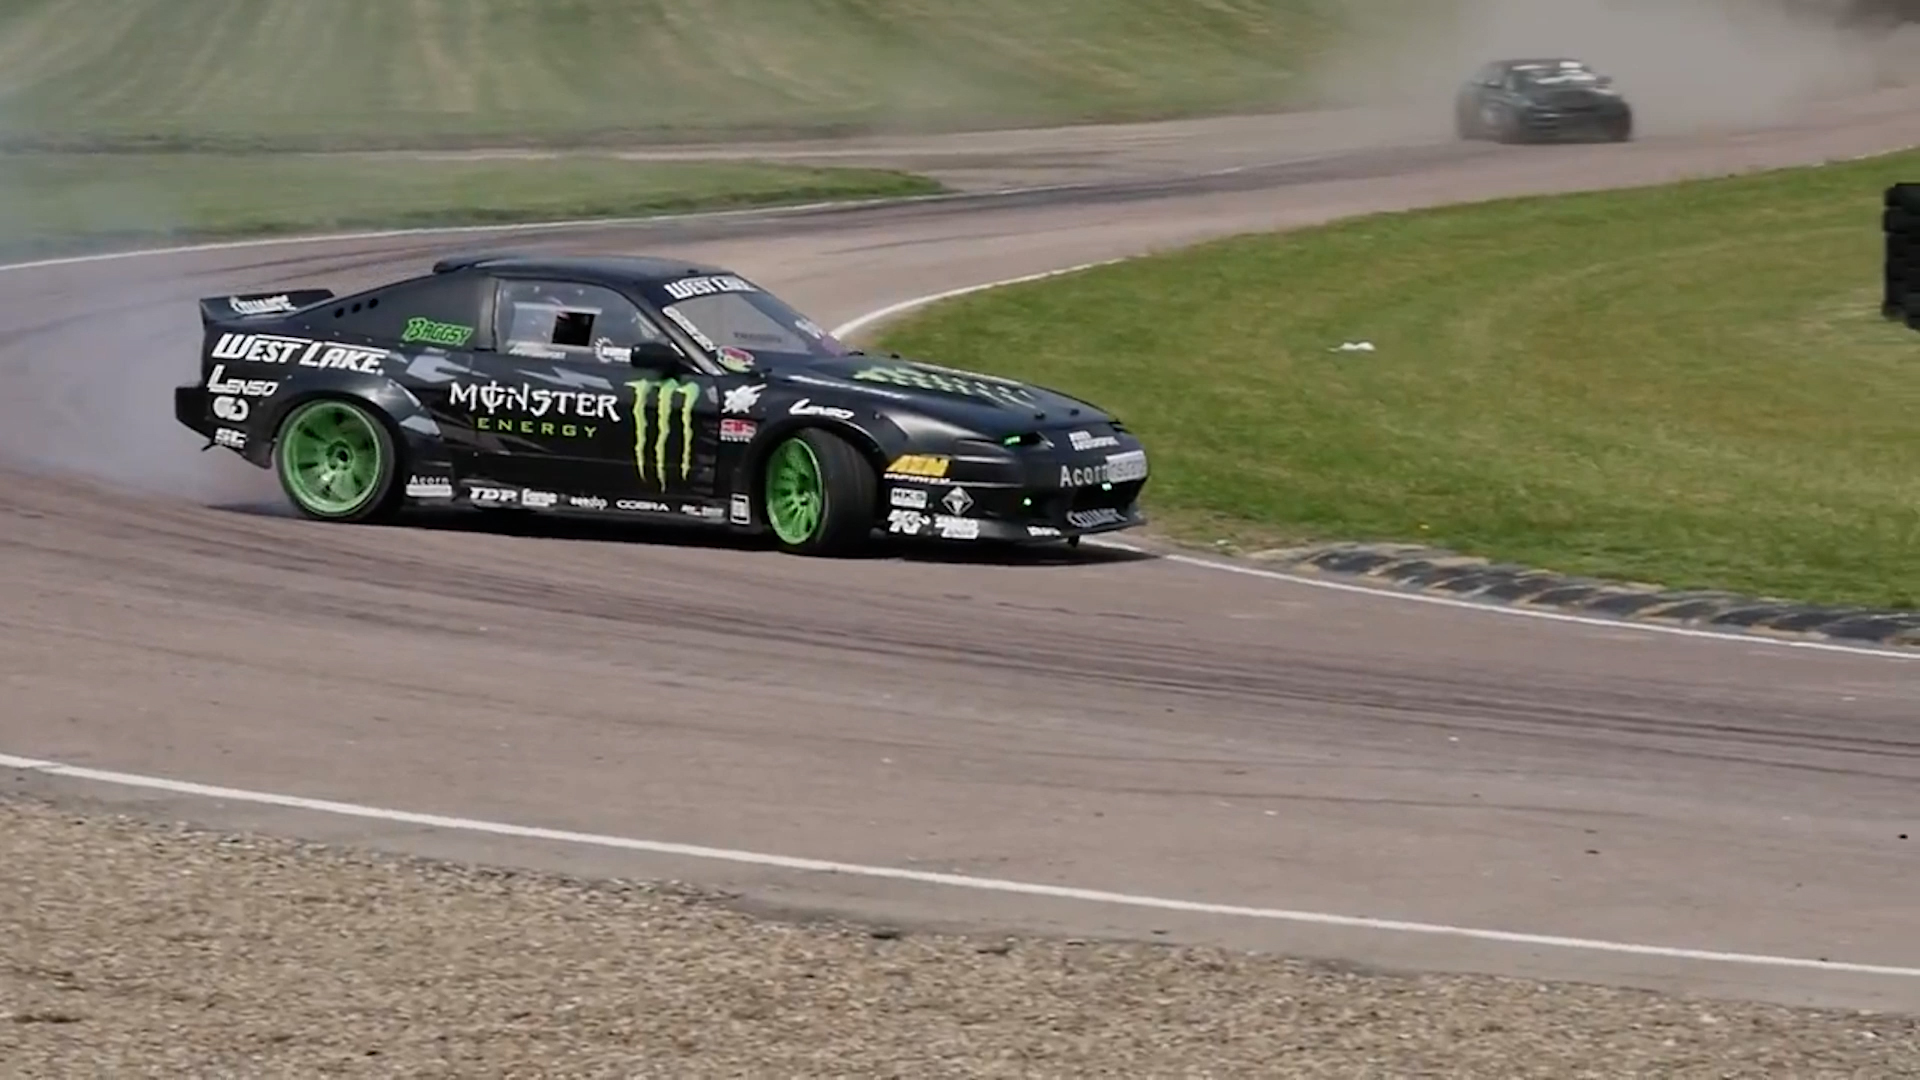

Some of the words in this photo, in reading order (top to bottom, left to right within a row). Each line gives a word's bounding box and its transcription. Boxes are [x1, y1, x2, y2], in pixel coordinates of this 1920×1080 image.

[211, 332, 313, 363] WEST
[207, 364, 279, 396] LENSO
[450, 379, 621, 422] MONSTER
[477, 417, 597, 438] ENERGY
[616, 499, 670, 512] COBRA
